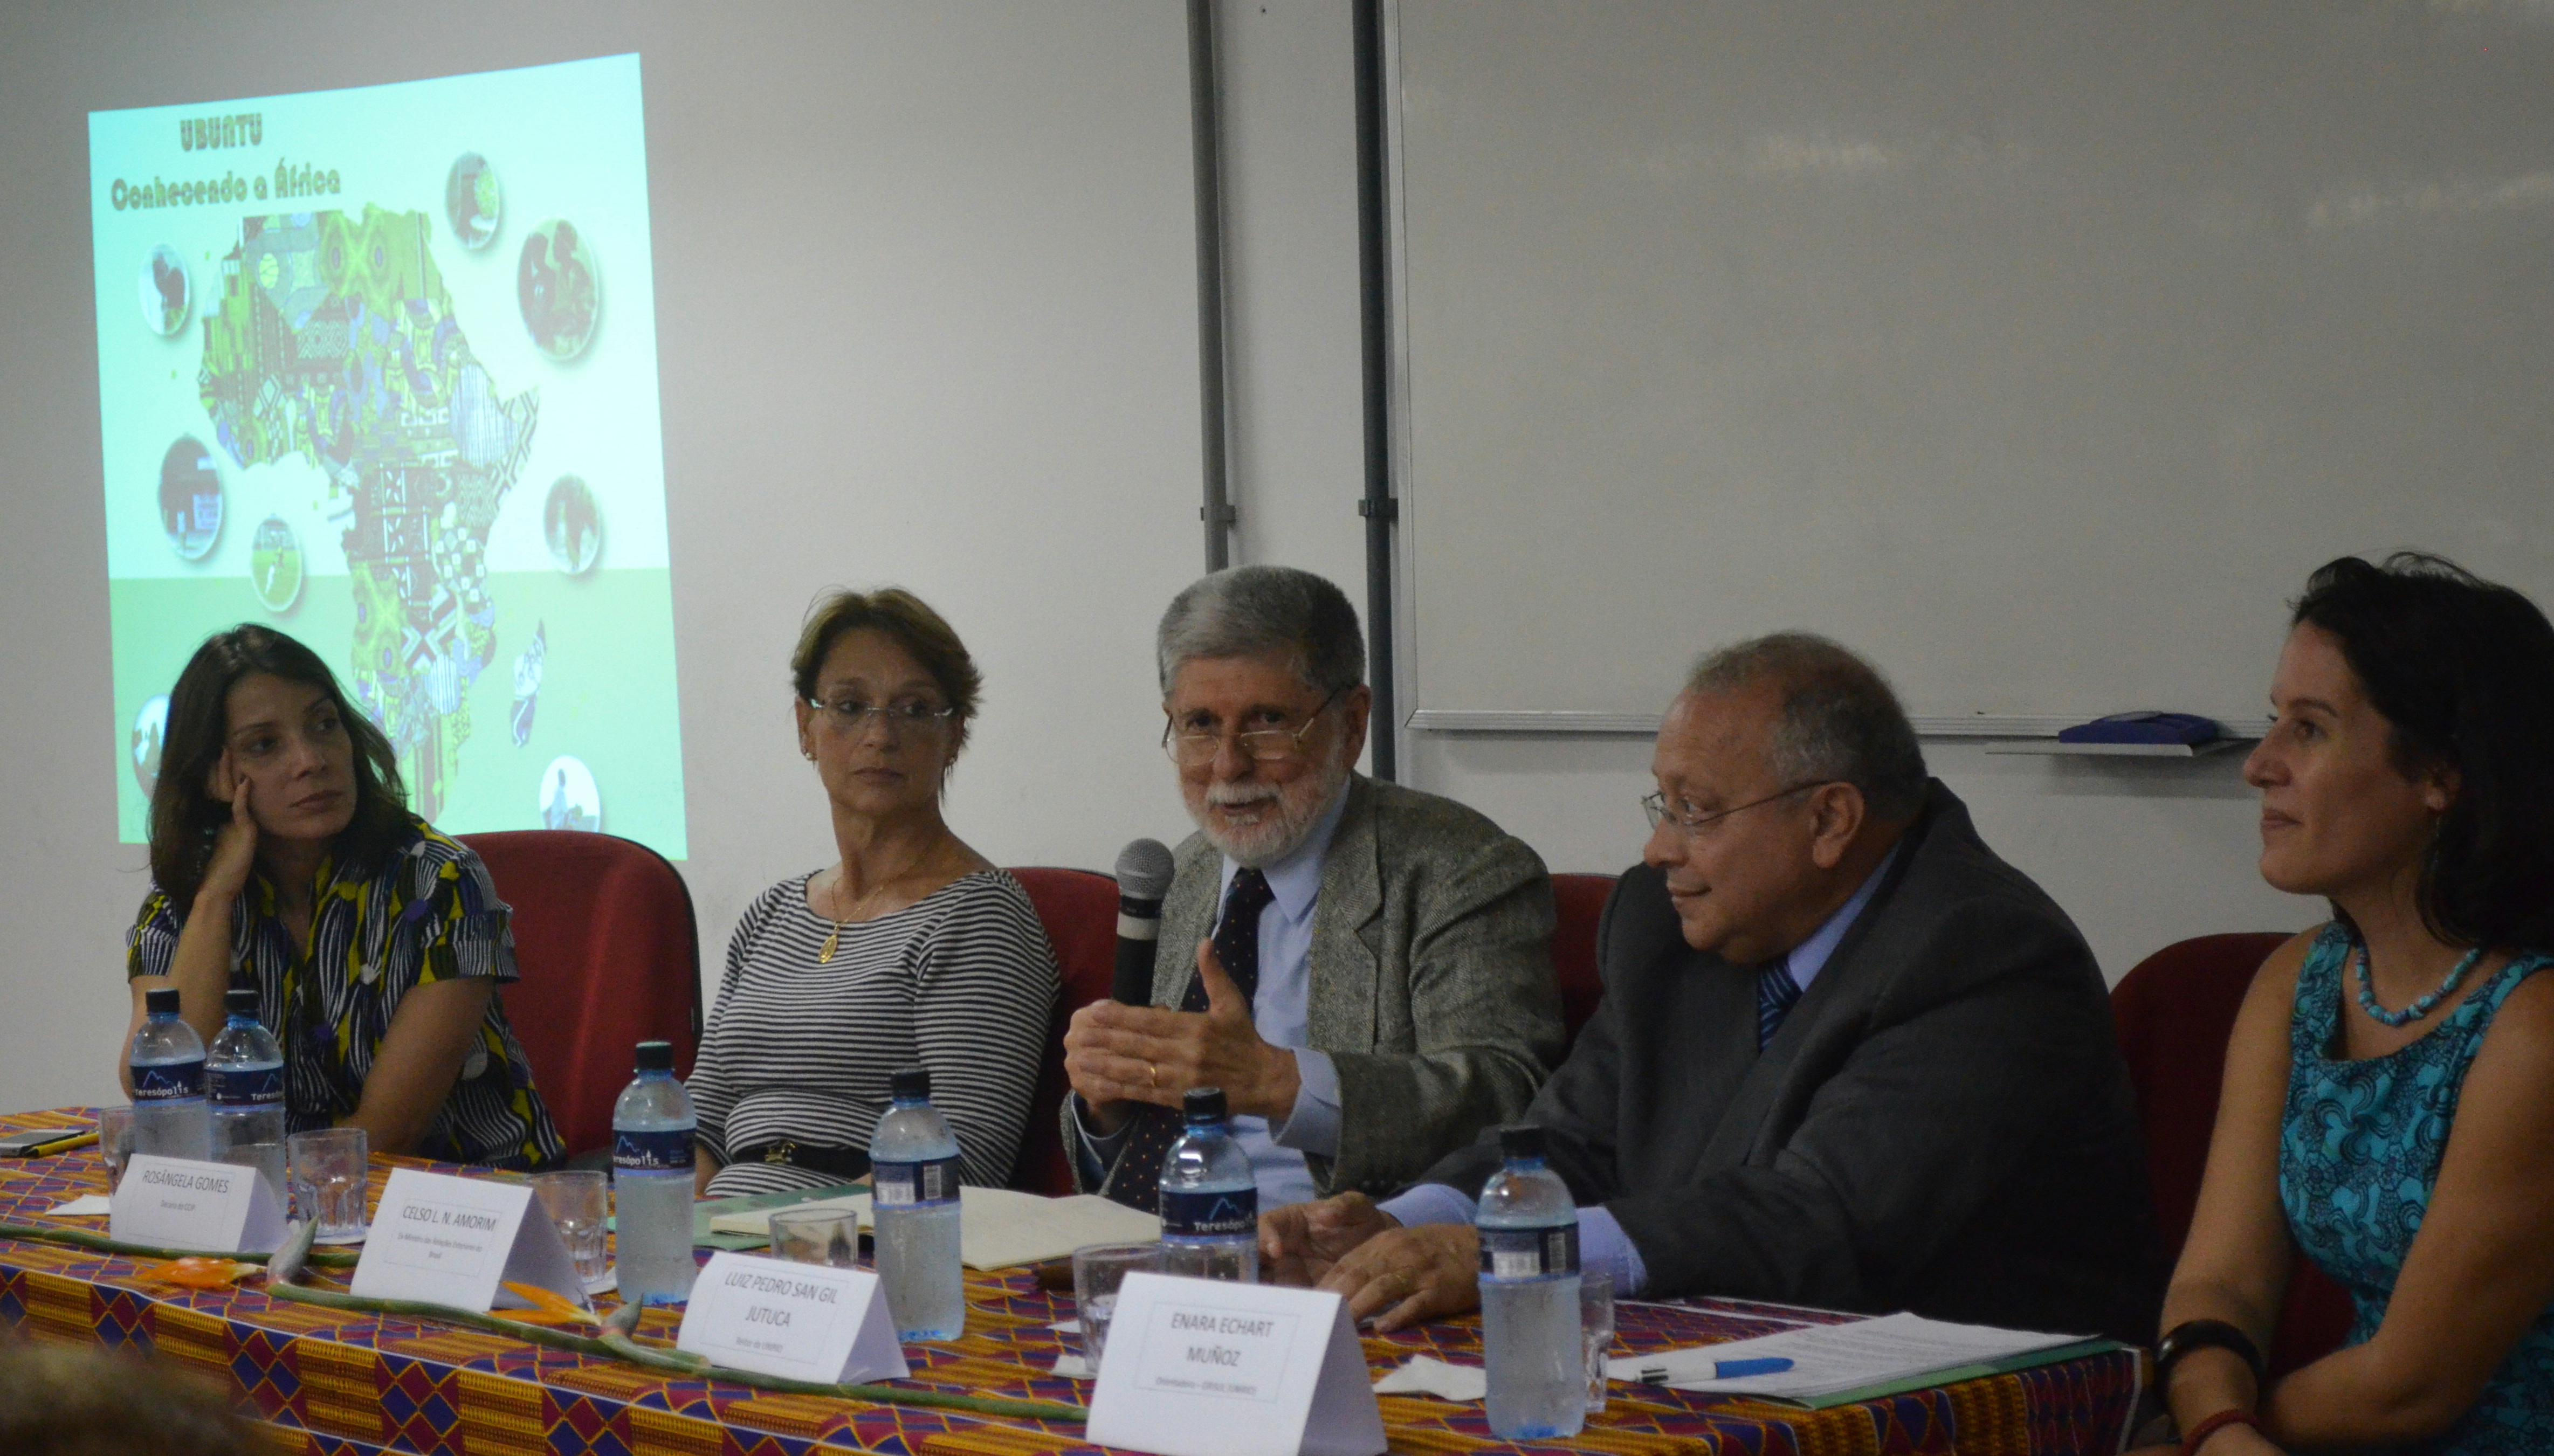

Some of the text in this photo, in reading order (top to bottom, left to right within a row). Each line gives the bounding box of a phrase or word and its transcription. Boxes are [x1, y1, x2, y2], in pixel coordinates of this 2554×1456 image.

[180, 113, 263, 152] UBUNTU
[111, 156, 341, 211] Conhecendo a África
[142, 1169, 229, 1193] ROSÂNGELA GOMES
[403, 1205, 432, 1222] CELSO
[441, 1211, 451, 1225] N.
[452, 1213, 497, 1232] AMORIM
[724, 1271, 838, 1305] LUIZ PEDRO SAN GIL
[745, 1305, 791, 1328] JUTUCA
[1171, 1312, 1275, 1338] ENARA ECHART
[1187, 1344, 1242, 1367] MUÑOZ
